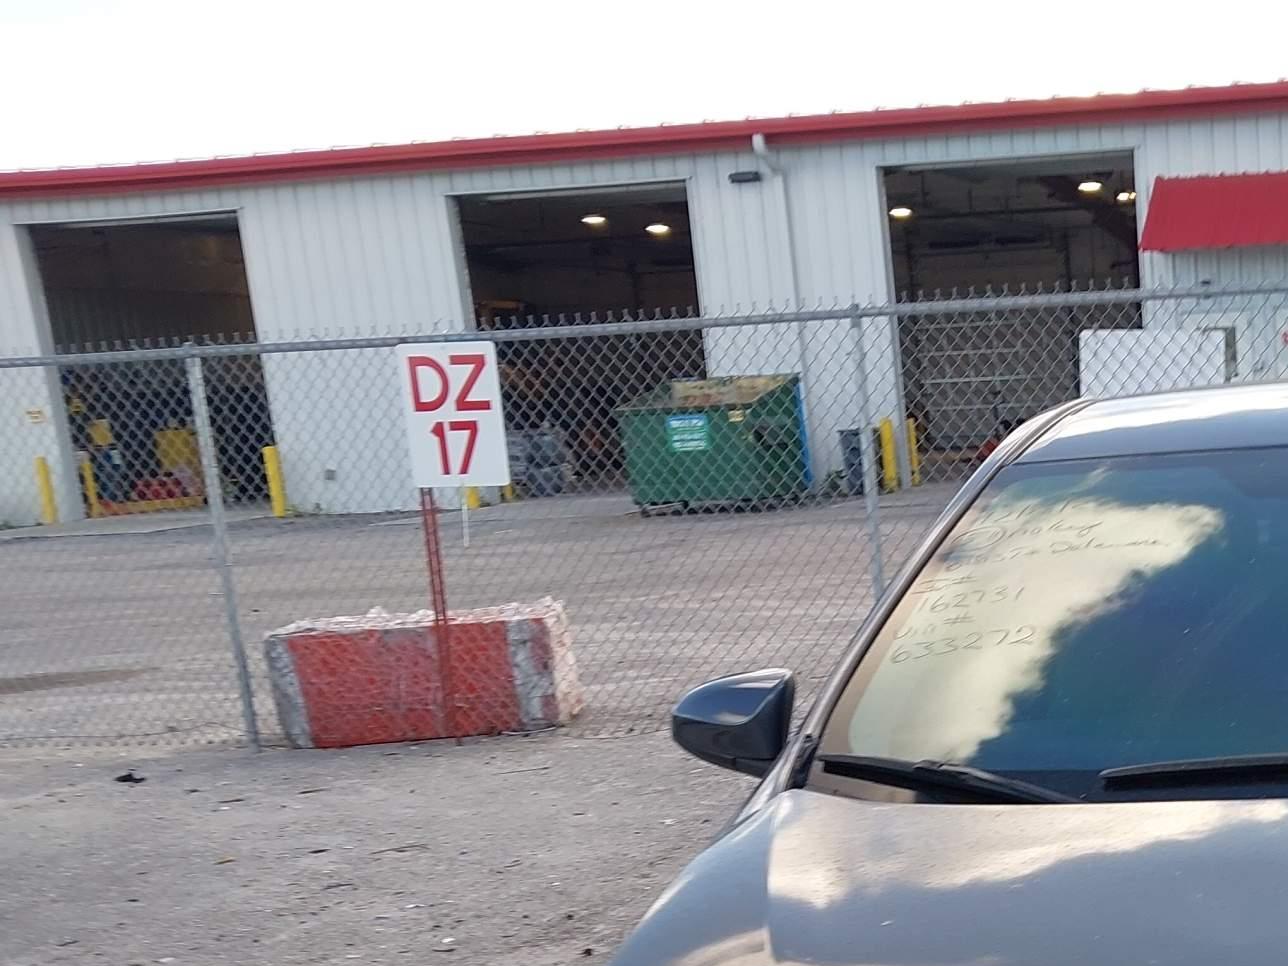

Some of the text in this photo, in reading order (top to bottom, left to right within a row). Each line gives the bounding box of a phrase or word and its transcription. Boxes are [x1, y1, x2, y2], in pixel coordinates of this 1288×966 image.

[408, 354, 491, 412] DZ
[431, 420, 478, 475] 17
[917, 585, 1025, 613] 162731
[890, 624, 1036, 664] 633272
